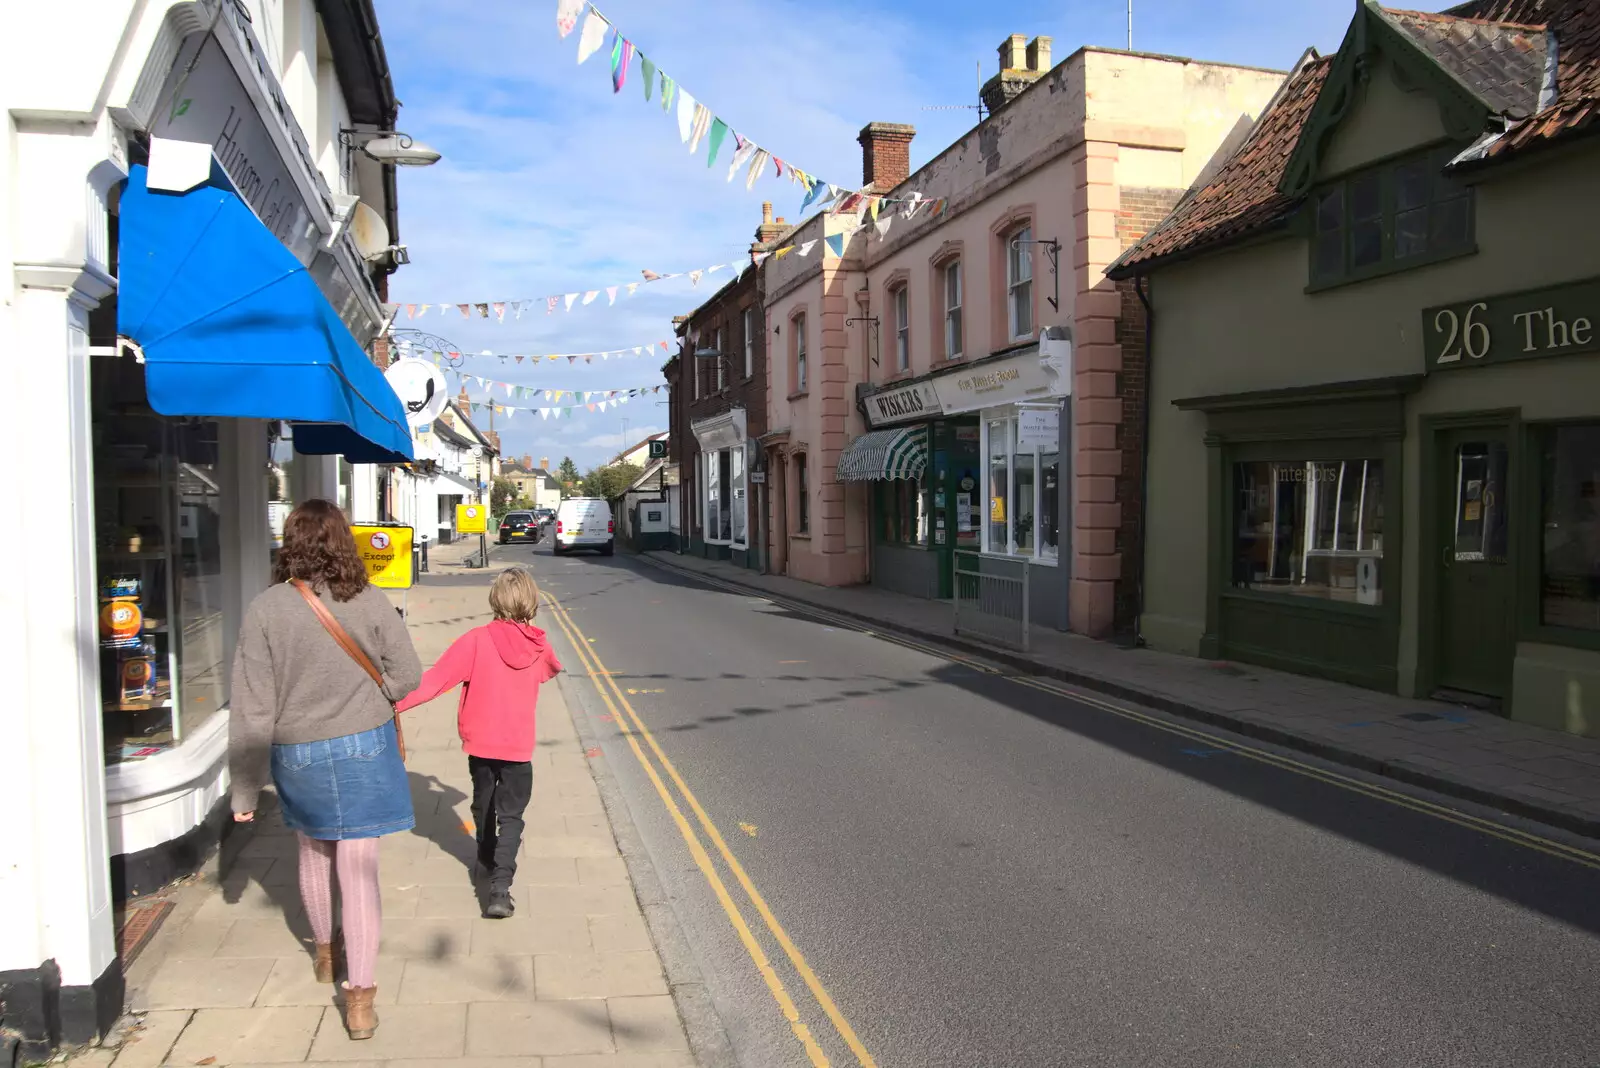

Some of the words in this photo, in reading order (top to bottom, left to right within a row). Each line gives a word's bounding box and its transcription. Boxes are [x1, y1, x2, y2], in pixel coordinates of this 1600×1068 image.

[1435, 302, 1491, 364] 26
[1513, 307, 1593, 352] The
[876, 388, 924, 418] WISKERS
[652, 442, 664, 454] D
[364, 552, 396, 563] Except
[372, 563, 386, 571] for
